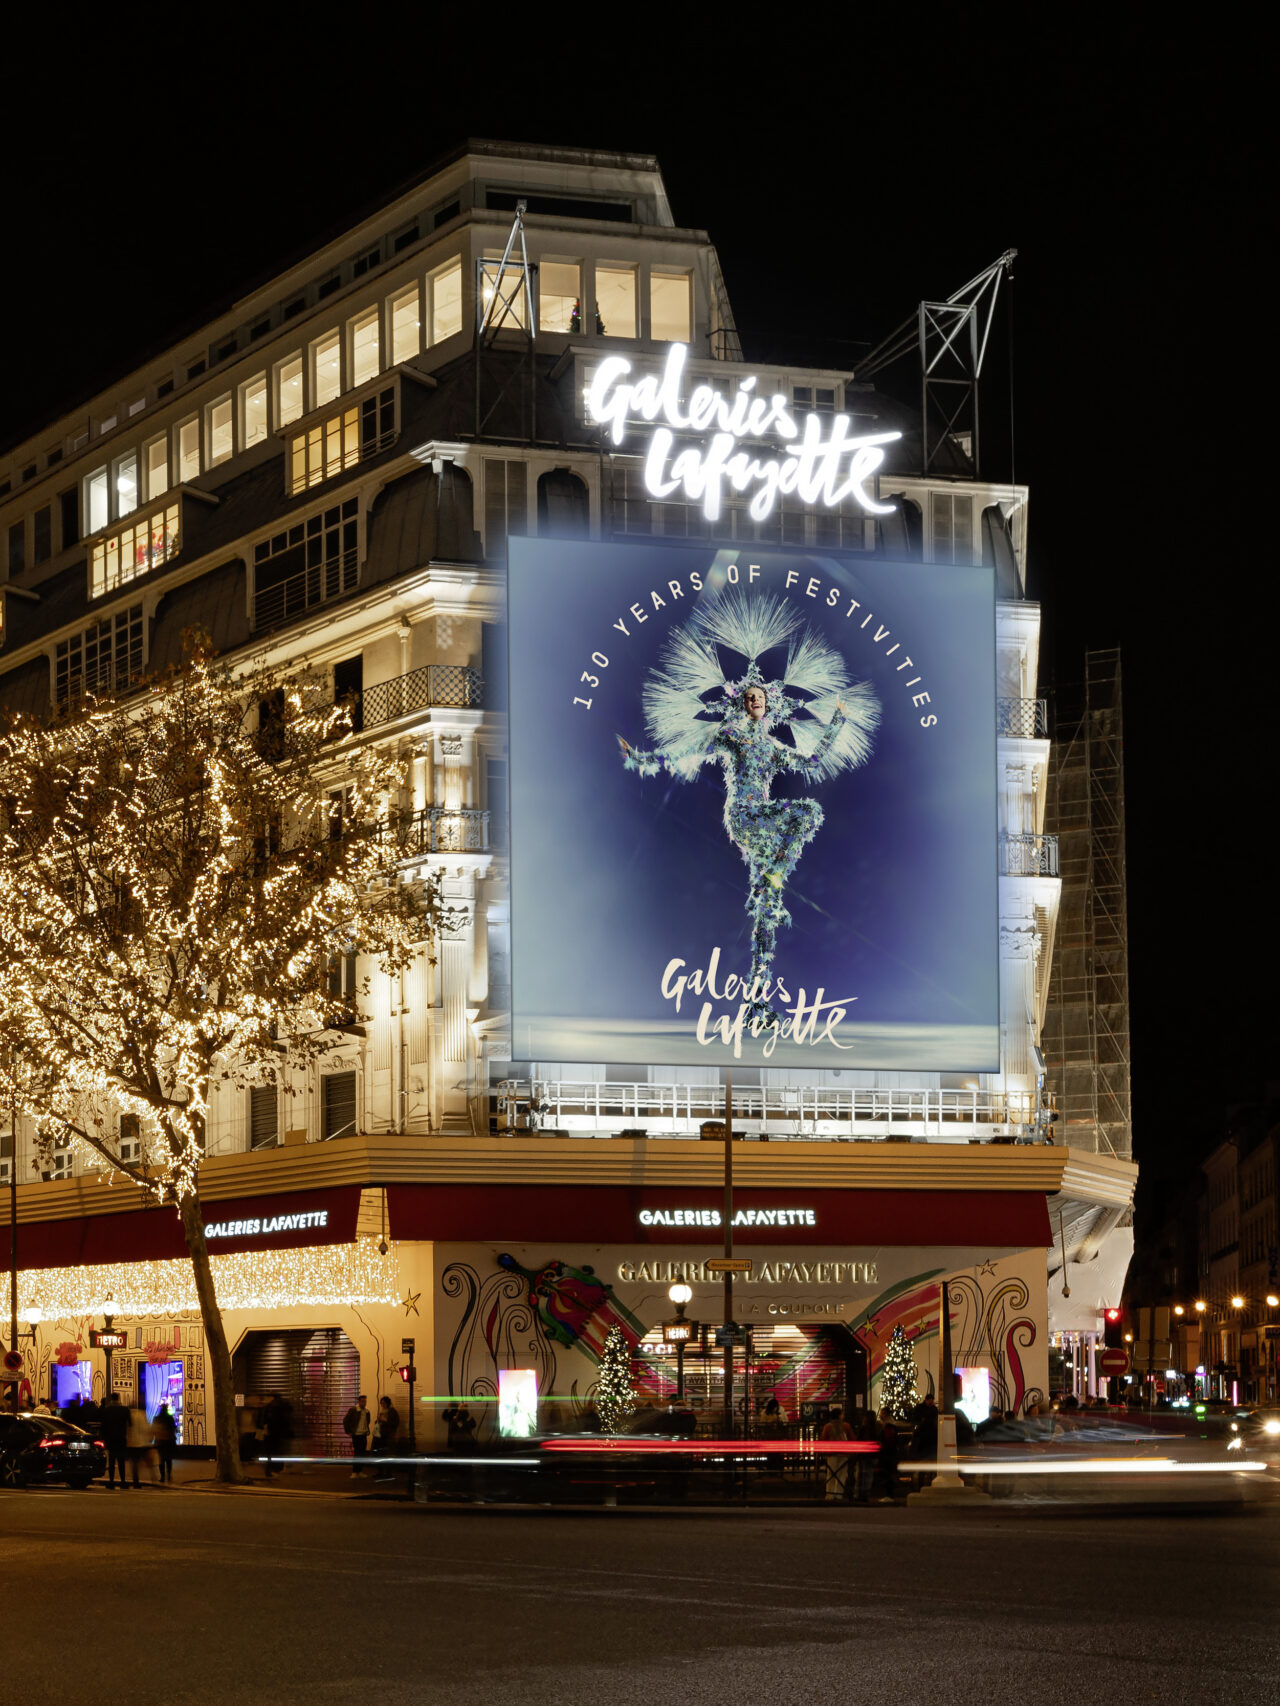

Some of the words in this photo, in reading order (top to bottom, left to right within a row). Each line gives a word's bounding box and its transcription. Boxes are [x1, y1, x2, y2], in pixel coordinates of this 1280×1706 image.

[589, 342, 798, 445] Galeries
[645, 414, 903, 521] Lafayette
[573, 651, 610, 710] 130
[613, 572, 703, 636] YEARS
[728, 565, 761, 583] OF
[785, 570, 937, 728] FESTIVITIES
[661, 946, 792, 1013] Galeries
[696, 988, 859, 1059] Lafayette
[204, 1219, 260, 1238] GALERIES
[262, 1211, 328, 1232] LAFAYETTE
[639, 1210, 721, 1226] GALERIES
[745, 1261, 879, 1283] LAFAYETTE
[768, 1304, 845, 1315] COUPOLE
